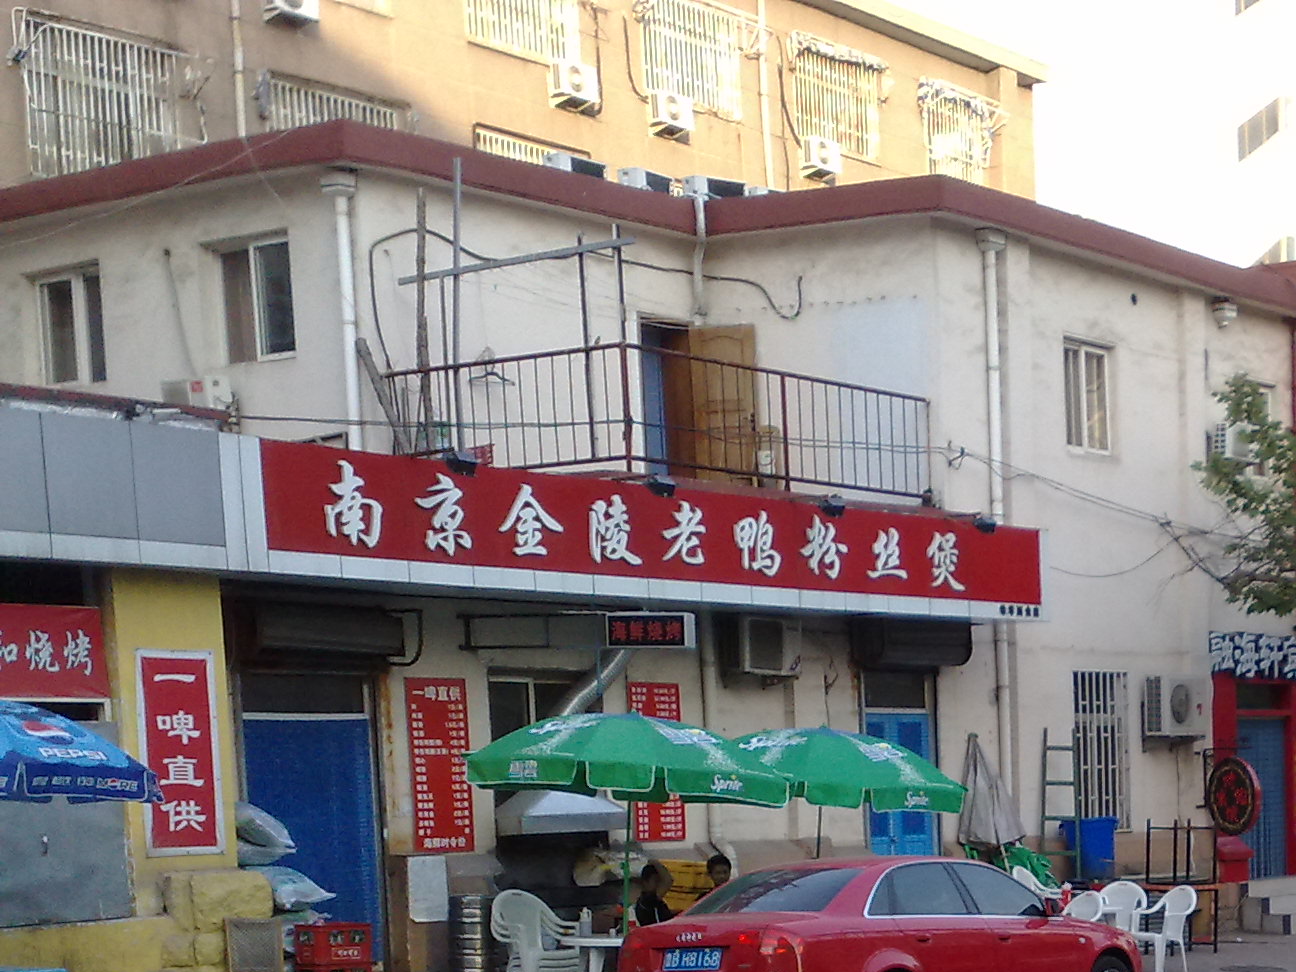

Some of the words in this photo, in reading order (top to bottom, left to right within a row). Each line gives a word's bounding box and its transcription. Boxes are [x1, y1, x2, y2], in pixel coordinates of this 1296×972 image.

[38, 747, 108, 761] PEPSI
[153, 672, 207, 832] 一啤直供
